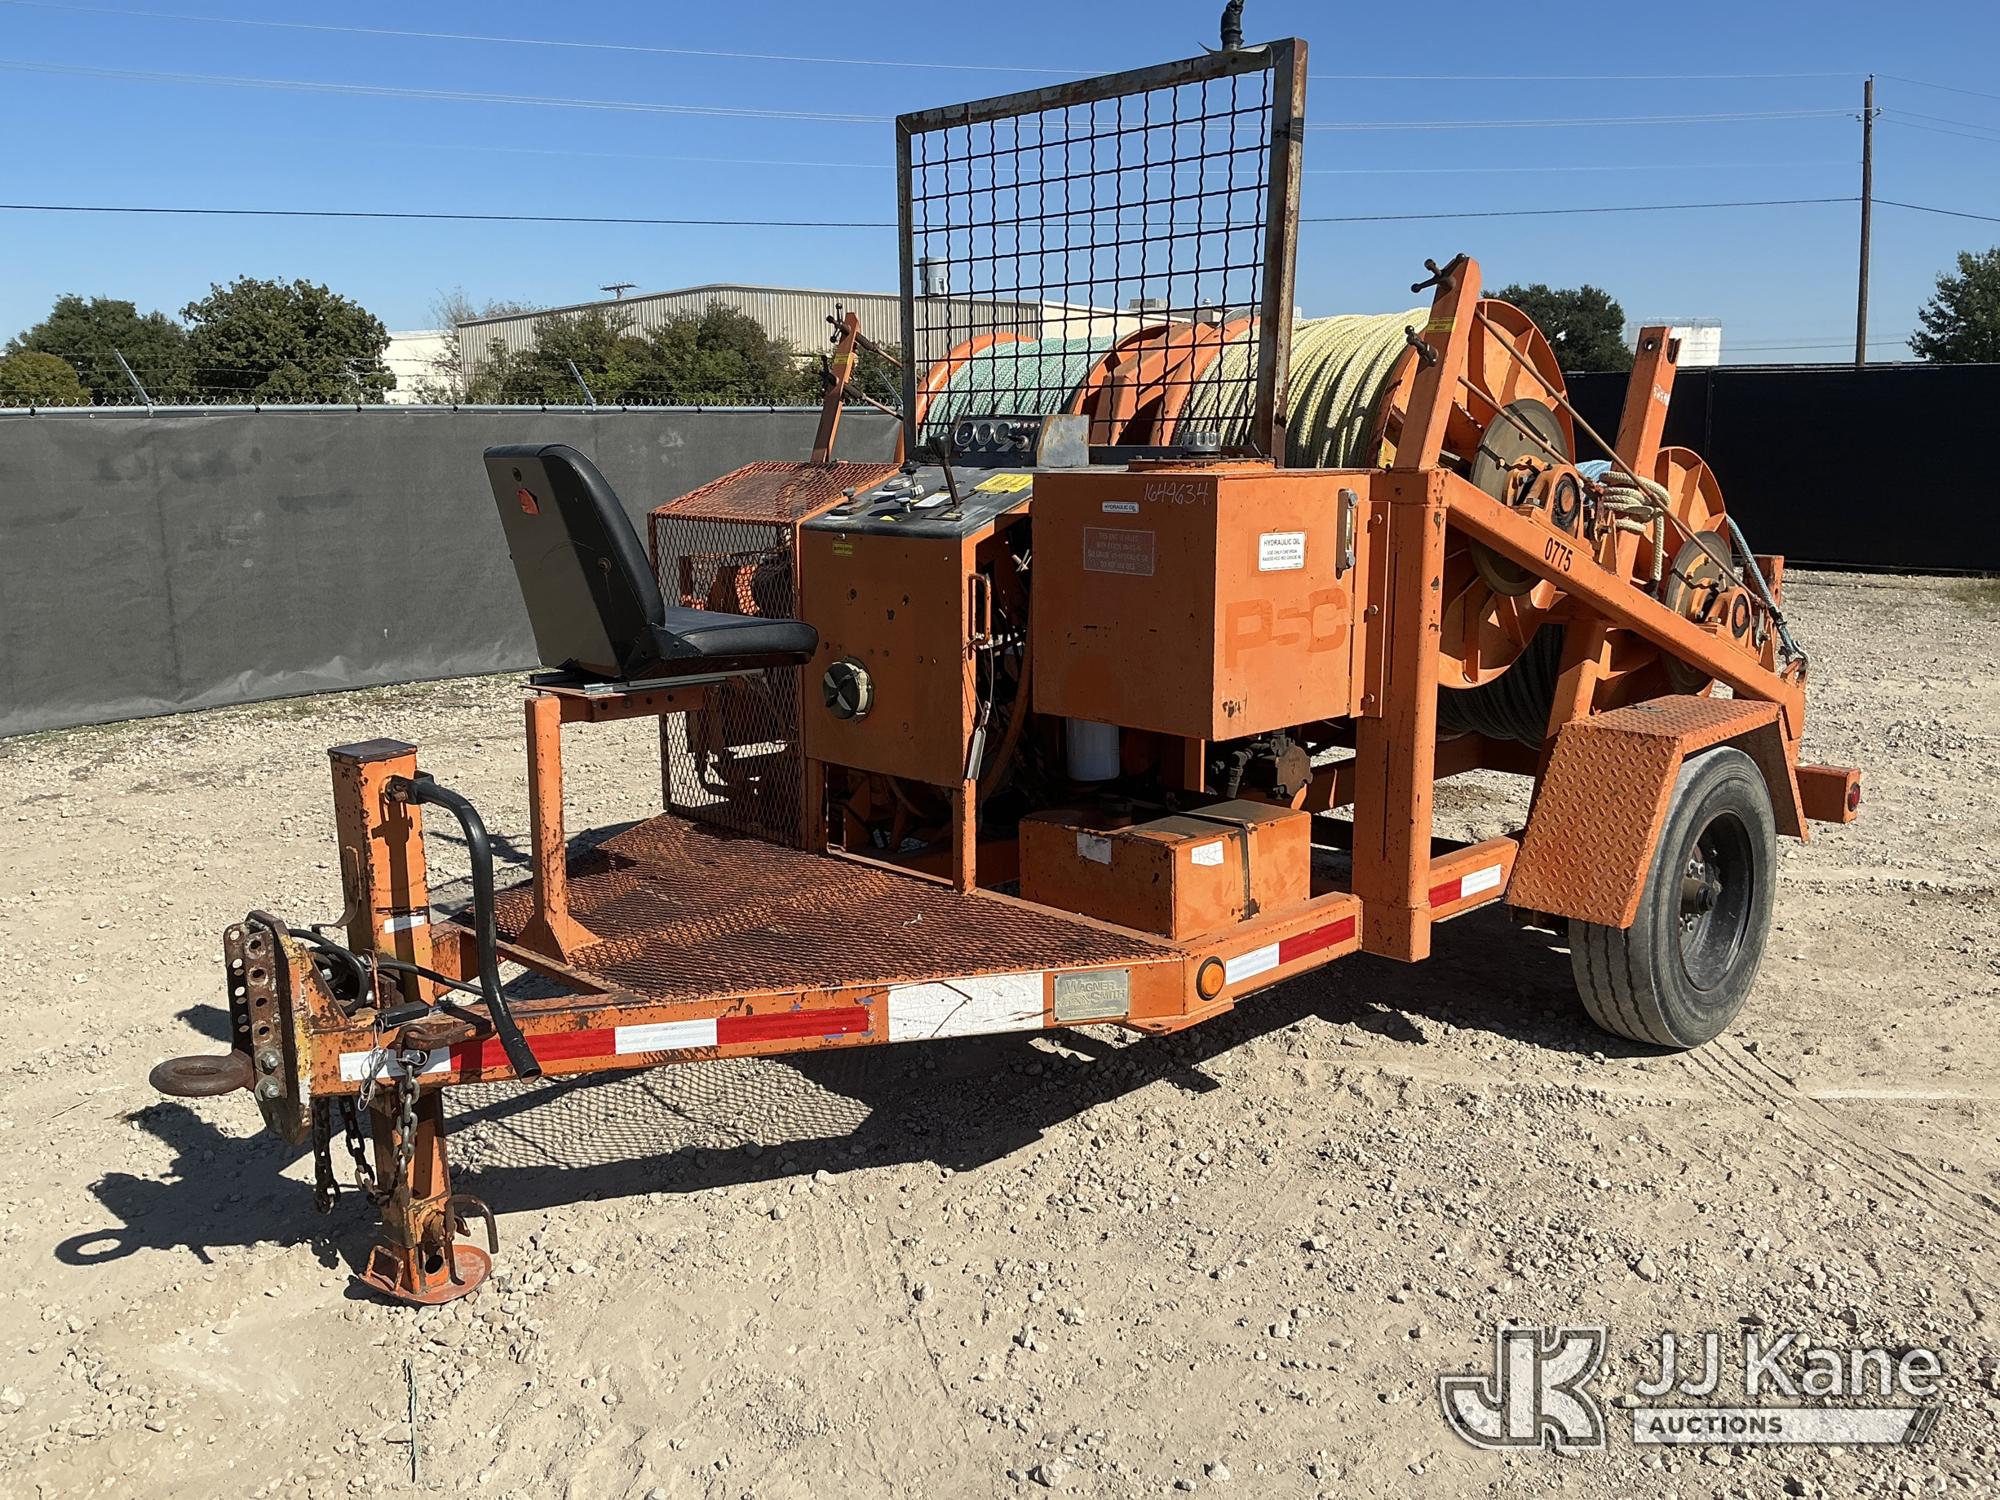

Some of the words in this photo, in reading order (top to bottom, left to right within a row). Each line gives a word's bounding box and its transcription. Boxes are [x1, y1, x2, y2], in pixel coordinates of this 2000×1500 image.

[1104, 503, 1128, 511] HYDRAULIC
[1263, 538, 1292, 547] HYDRAULIC
[1292, 537, 1301, 545] OIL
[1544, 537, 1573, 572] 0775
[1064, 979, 1117, 995] WAGNER
[1090, 988, 1125, 1005] SMITH
